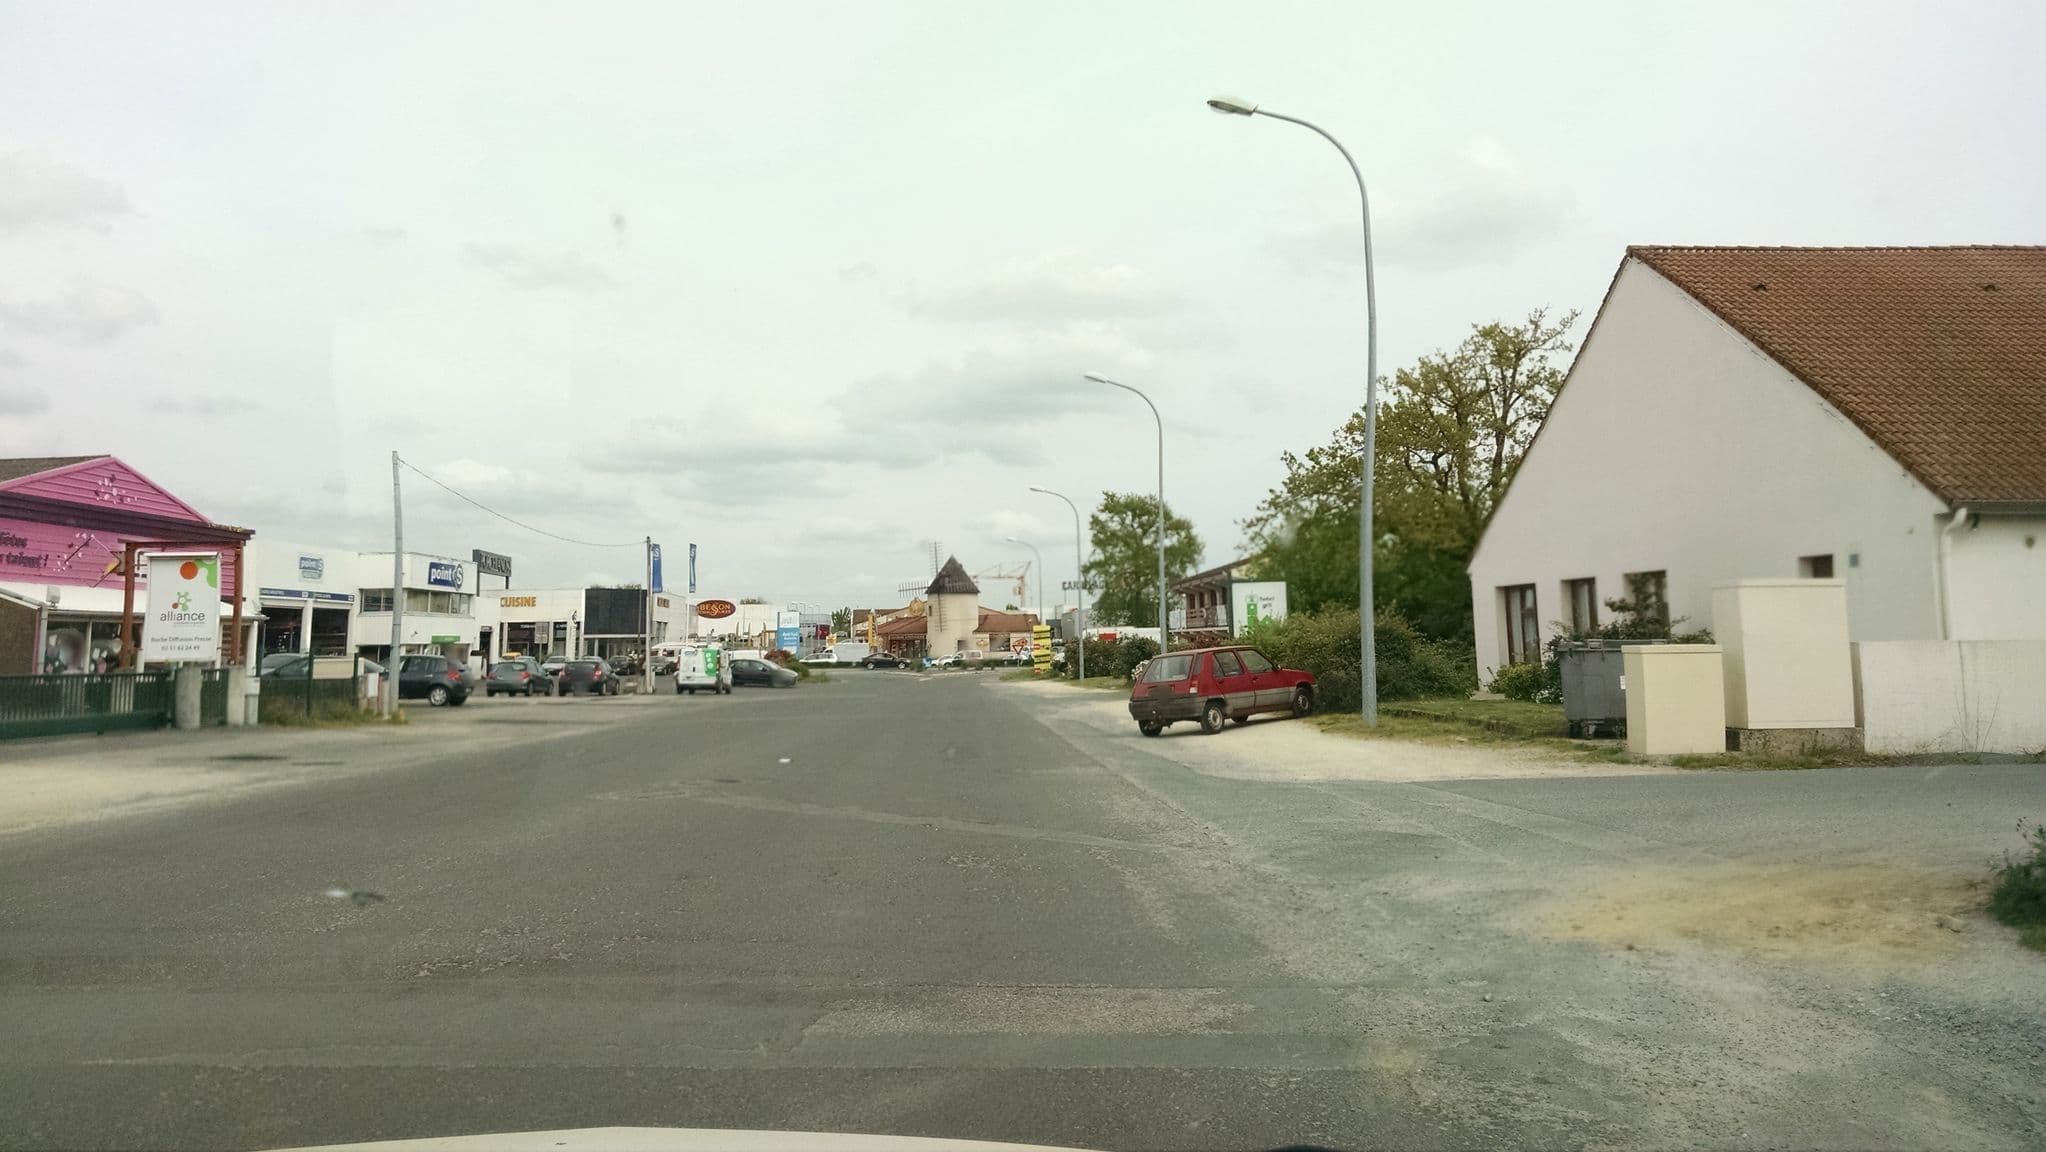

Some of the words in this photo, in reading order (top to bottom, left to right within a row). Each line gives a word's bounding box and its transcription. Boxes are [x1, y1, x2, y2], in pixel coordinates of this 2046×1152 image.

[431, 566, 452, 582] point
[500, 596, 537, 608] CUISINE
[160, 611, 206, 622] alliance
